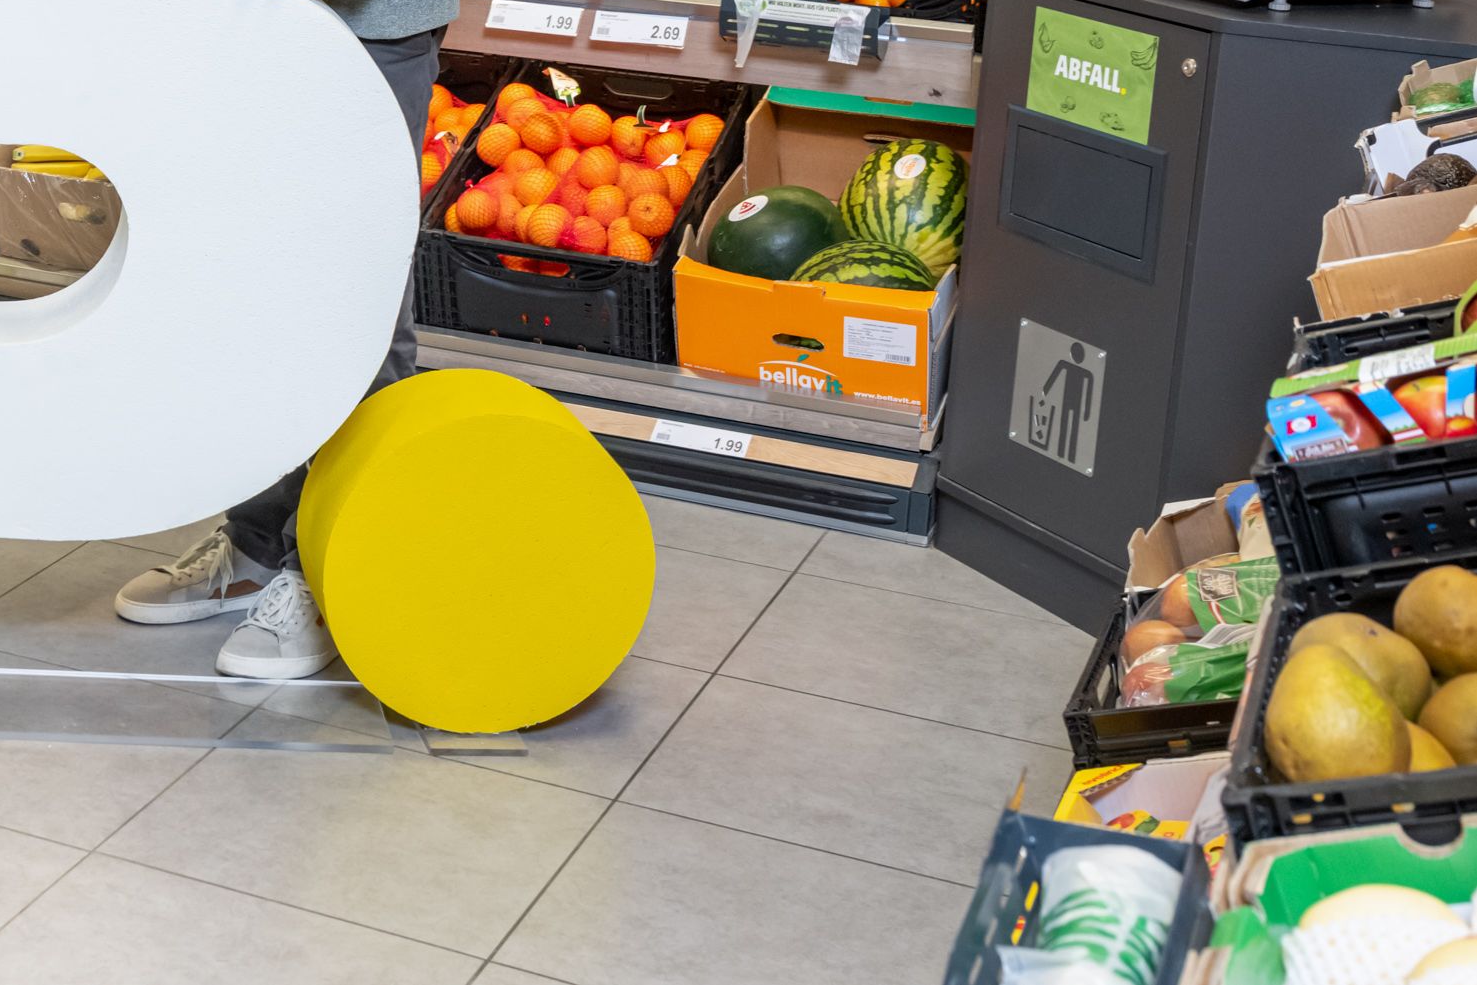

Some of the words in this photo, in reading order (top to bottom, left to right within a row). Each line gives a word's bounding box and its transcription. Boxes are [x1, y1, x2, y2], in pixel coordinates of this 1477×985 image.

[545, 14, 573, 30] 1.99
[650, 25, 680, 41] 2.69
[1054, 54, 1127, 95] ABFALL.
[759, 366, 844, 395] bellavit
[853, 390, 921, 406] www.bellavit.es
[713, 437, 743, 453] 1.99
